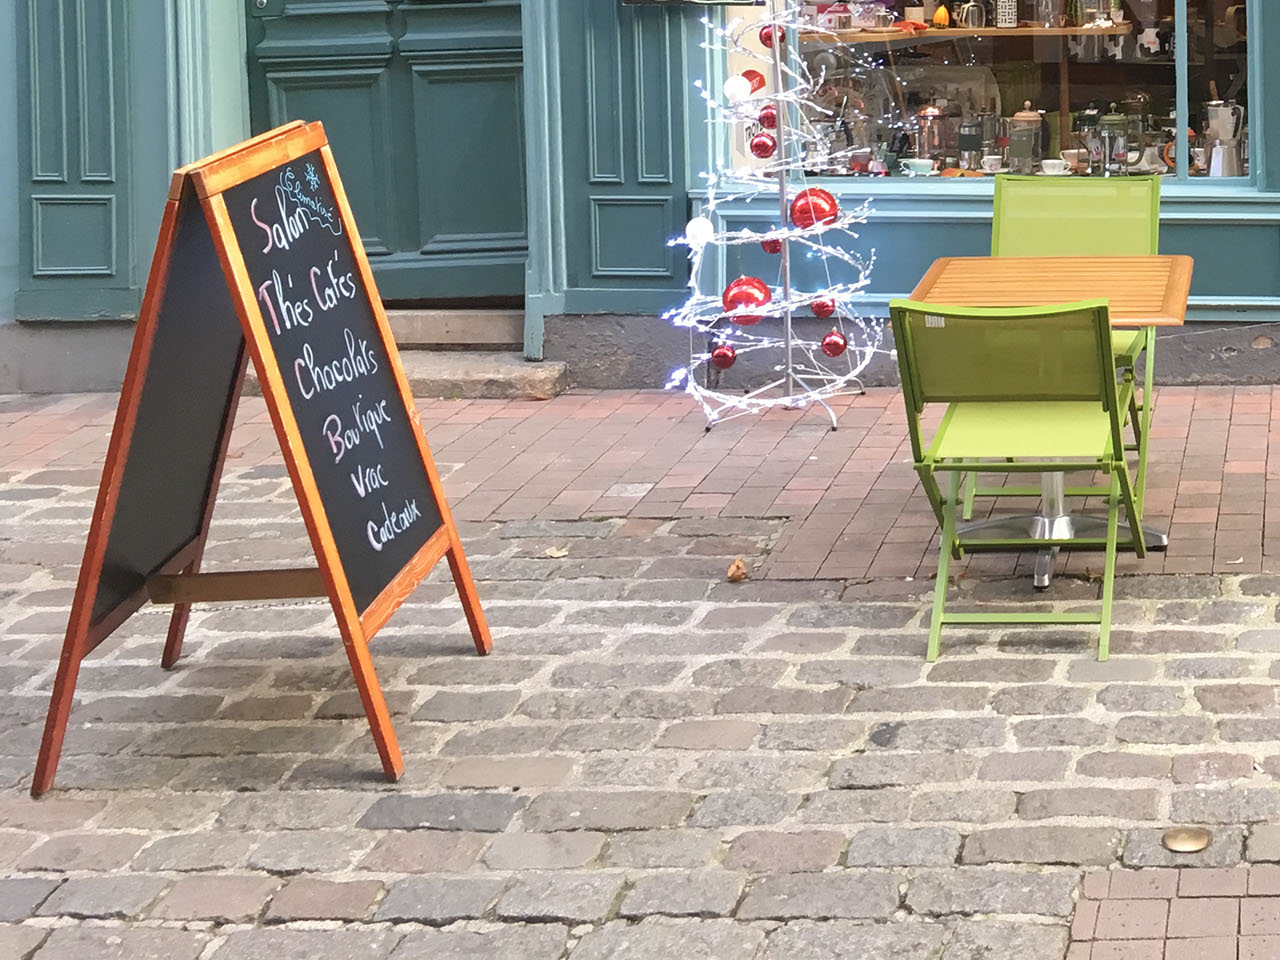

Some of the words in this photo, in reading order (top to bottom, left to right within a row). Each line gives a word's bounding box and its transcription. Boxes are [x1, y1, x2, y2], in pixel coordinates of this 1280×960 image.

[251, 185, 309, 254] Salon
[259, 269, 313, 336] Thés
[310, 250, 356, 311] Cafés
[294, 327, 378, 400] Chocolats
[323, 394, 392, 464] Boutique
[367, 497, 421, 552] Cadeaux
